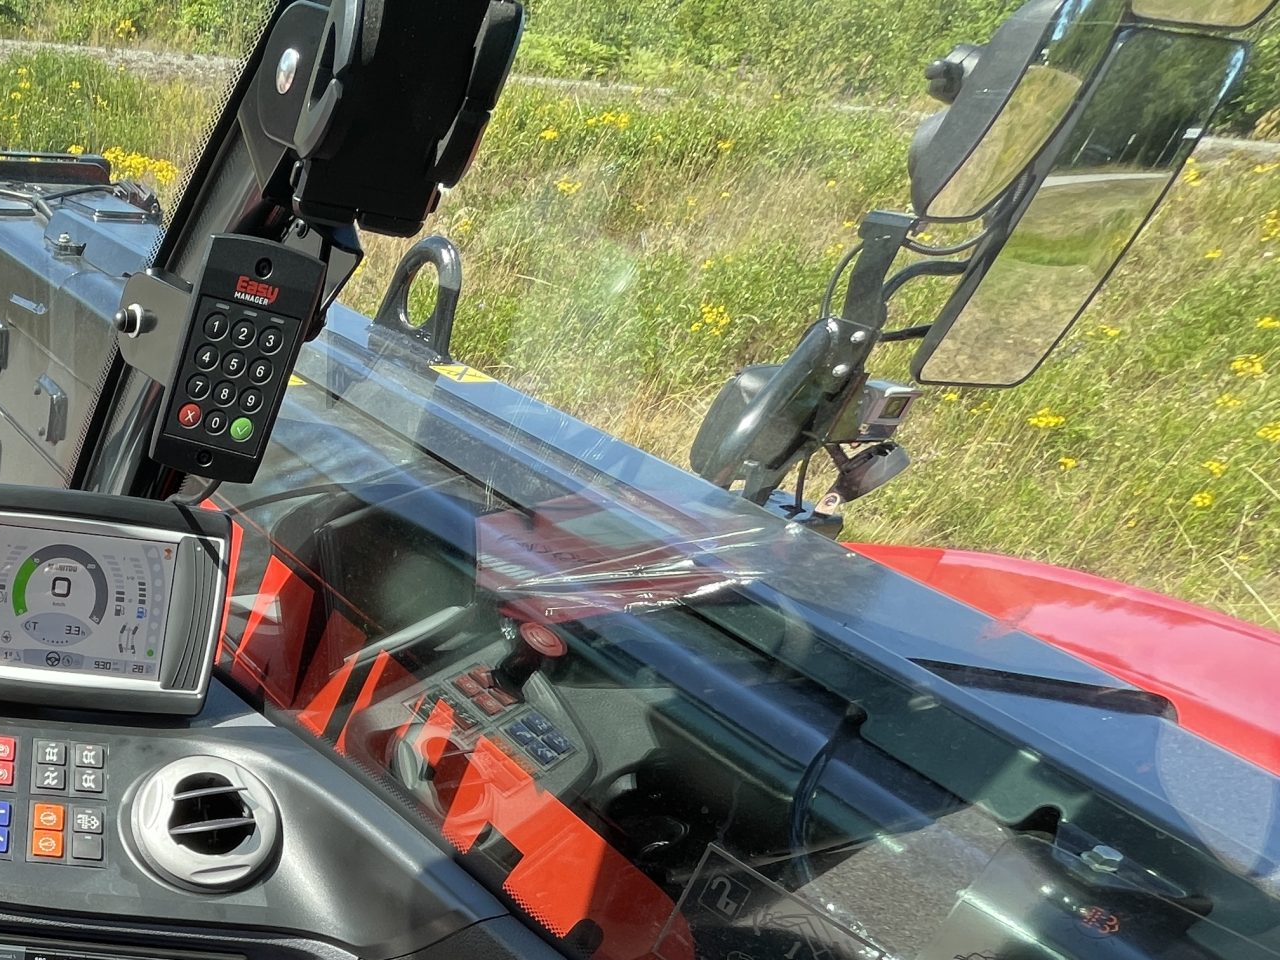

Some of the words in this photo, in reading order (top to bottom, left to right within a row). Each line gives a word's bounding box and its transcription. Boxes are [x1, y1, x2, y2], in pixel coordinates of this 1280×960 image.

[233, 291, 269, 306] MANAGER
[235, 275, 280, 304] Easy
[213, 320, 220, 333] 1
[238, 328, 248, 340] 2
[265, 335, 275, 347] 3
[202, 352, 211, 363] 4
[229, 358, 238, 370] 5
[256, 365, 265, 377] 6
[195, 382, 204, 393] 7
[220, 388, 229, 400] 8
[246, 394, 255, 406] 9
[211, 417, 220, 429] 0
[51, 576, 71, 598] 0
[94, 660, 112, 670] 930
